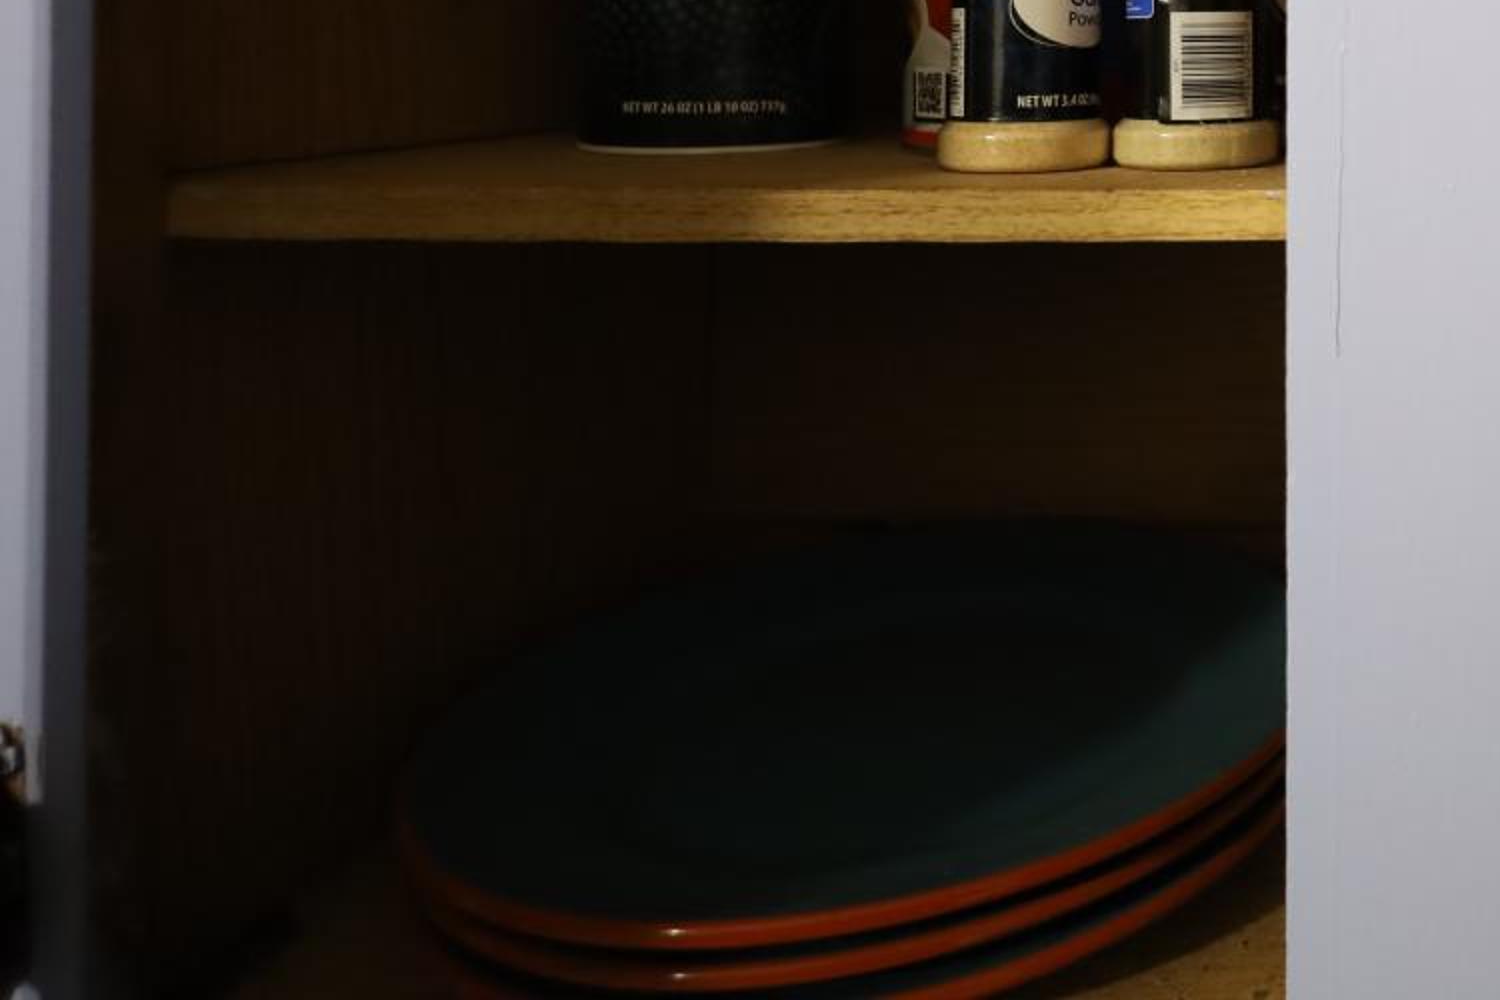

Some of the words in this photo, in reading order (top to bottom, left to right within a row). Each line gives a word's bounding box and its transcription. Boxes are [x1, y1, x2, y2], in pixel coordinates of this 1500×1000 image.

[623, 100, 641, 114] NET
[642, 100, 659, 114] WT
[660, 100, 675, 115] 26
[1017, 94, 1040, 108] NET
[1041, 94, 1059, 107] WT
